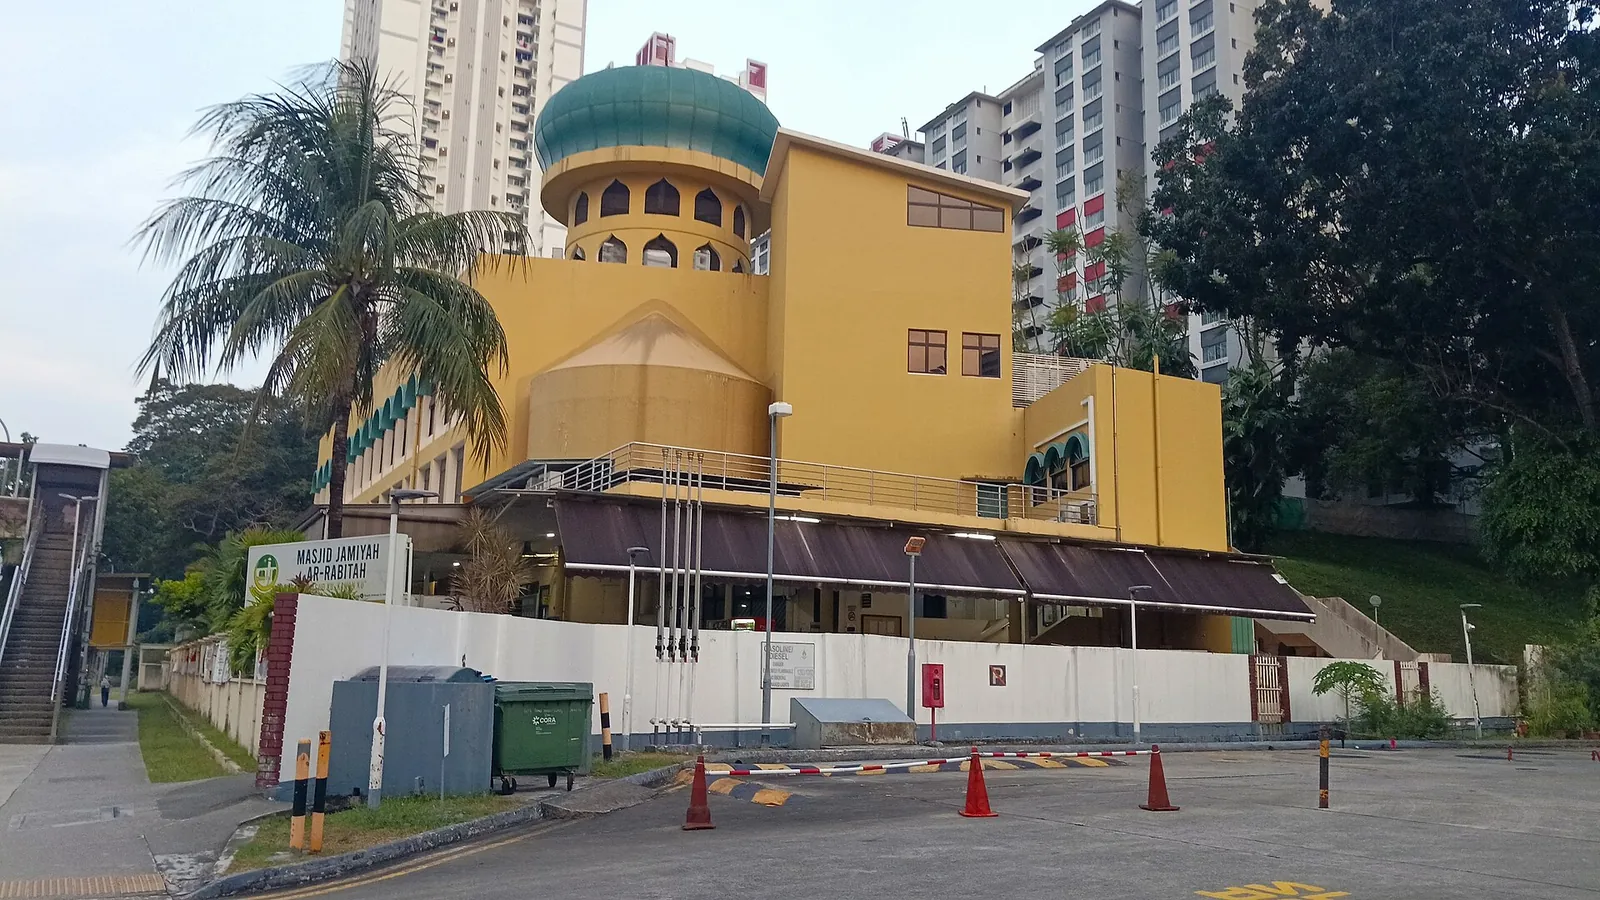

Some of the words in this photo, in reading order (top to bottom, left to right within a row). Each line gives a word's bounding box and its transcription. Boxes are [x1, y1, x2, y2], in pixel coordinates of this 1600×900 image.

[297, 547, 332, 565] MASJID
[335, 543, 380, 562] JAMIYAH
[307, 562, 366, 582] AR-RABITAH
